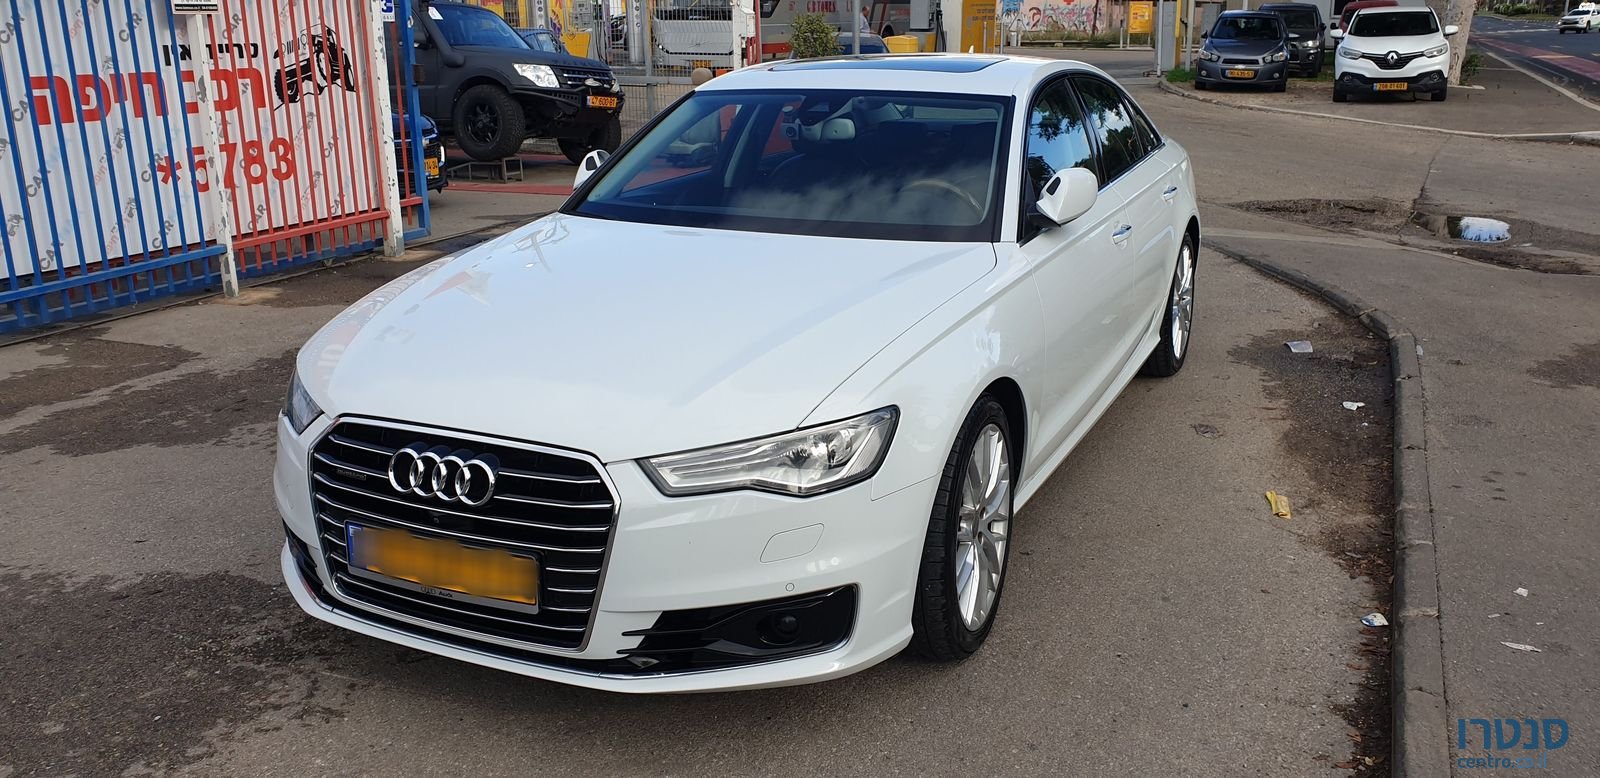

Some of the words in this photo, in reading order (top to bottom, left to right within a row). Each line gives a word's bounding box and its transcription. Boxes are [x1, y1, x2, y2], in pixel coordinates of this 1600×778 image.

[0, 12, 25, 44] CA
[12, 93, 30, 122] CA
[29, 72, 169, 126] חיפה
[26, 167, 51, 197] CA
[39, 240, 64, 270] CA
